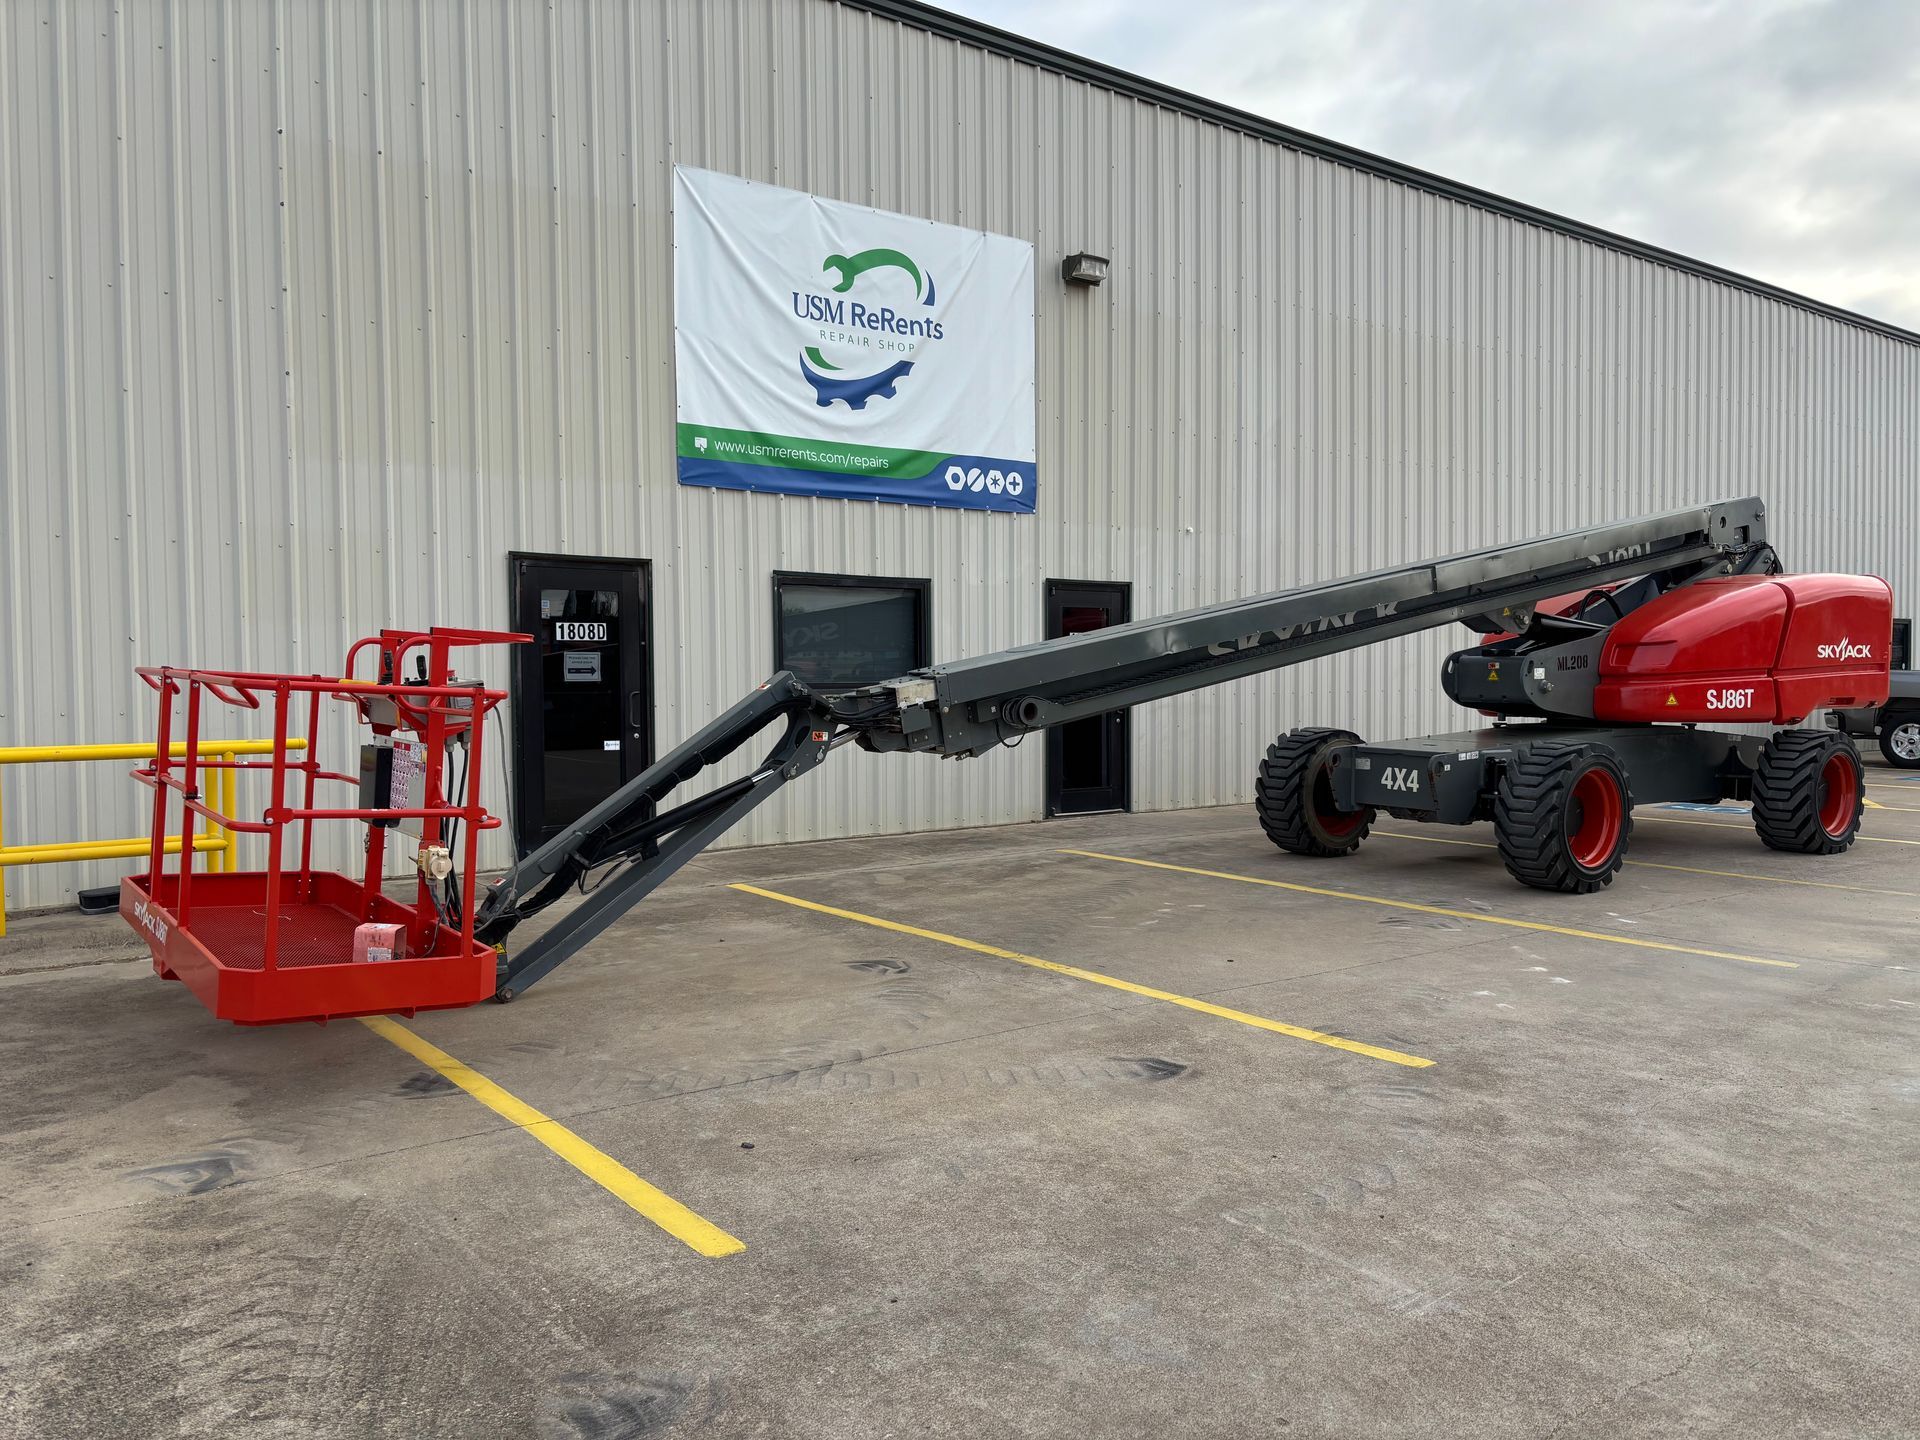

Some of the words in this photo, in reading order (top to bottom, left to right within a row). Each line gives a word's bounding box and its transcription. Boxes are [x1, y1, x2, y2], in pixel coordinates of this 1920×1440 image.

[792, 292, 845, 325] USM
[851, 302, 944, 340] ReRents
[819, 330, 870, 347] REPAIR
[878, 339, 915, 352] SHOP
[714, 440, 889, 468] www.usmrerents.com/repairs
[558, 623, 605, 640] 1808D
[1817, 636, 1871, 661] SKYJACK
[1557, 654, 1588, 672] ML208
[1706, 688, 1754, 710] SJ86T
[1380, 766, 1420, 793] 4X4
